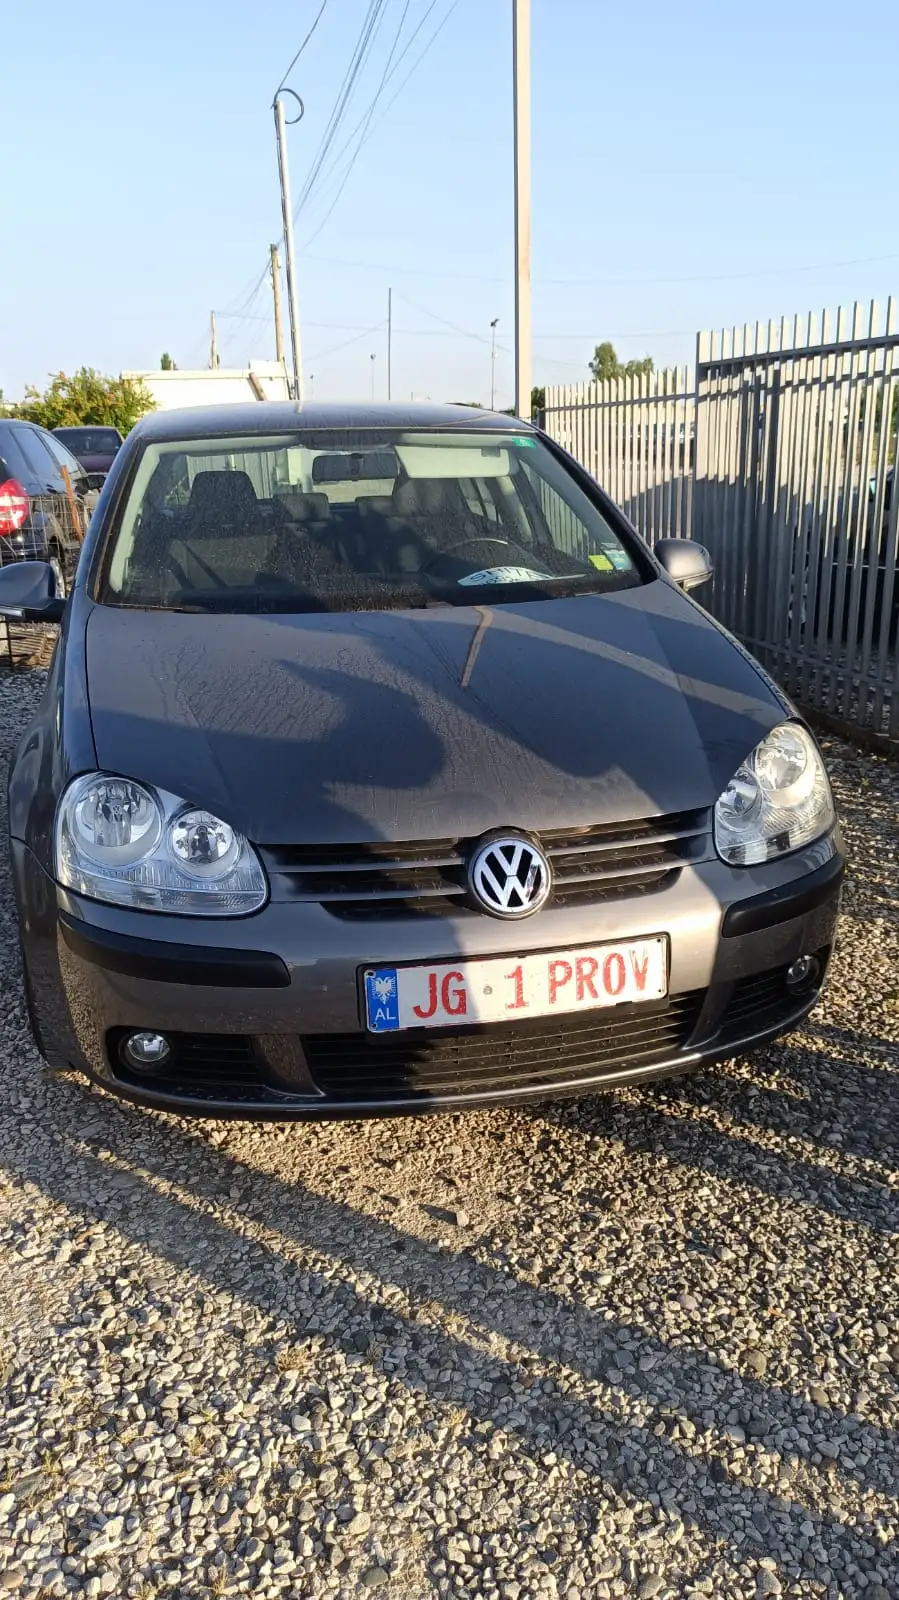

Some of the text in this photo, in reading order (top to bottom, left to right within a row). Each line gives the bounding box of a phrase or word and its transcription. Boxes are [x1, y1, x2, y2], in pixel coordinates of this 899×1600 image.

[475, 839, 545, 911] VW
[375, 1007, 396, 1021] AL
[413, 948, 648, 1018] JG 1 PROV
